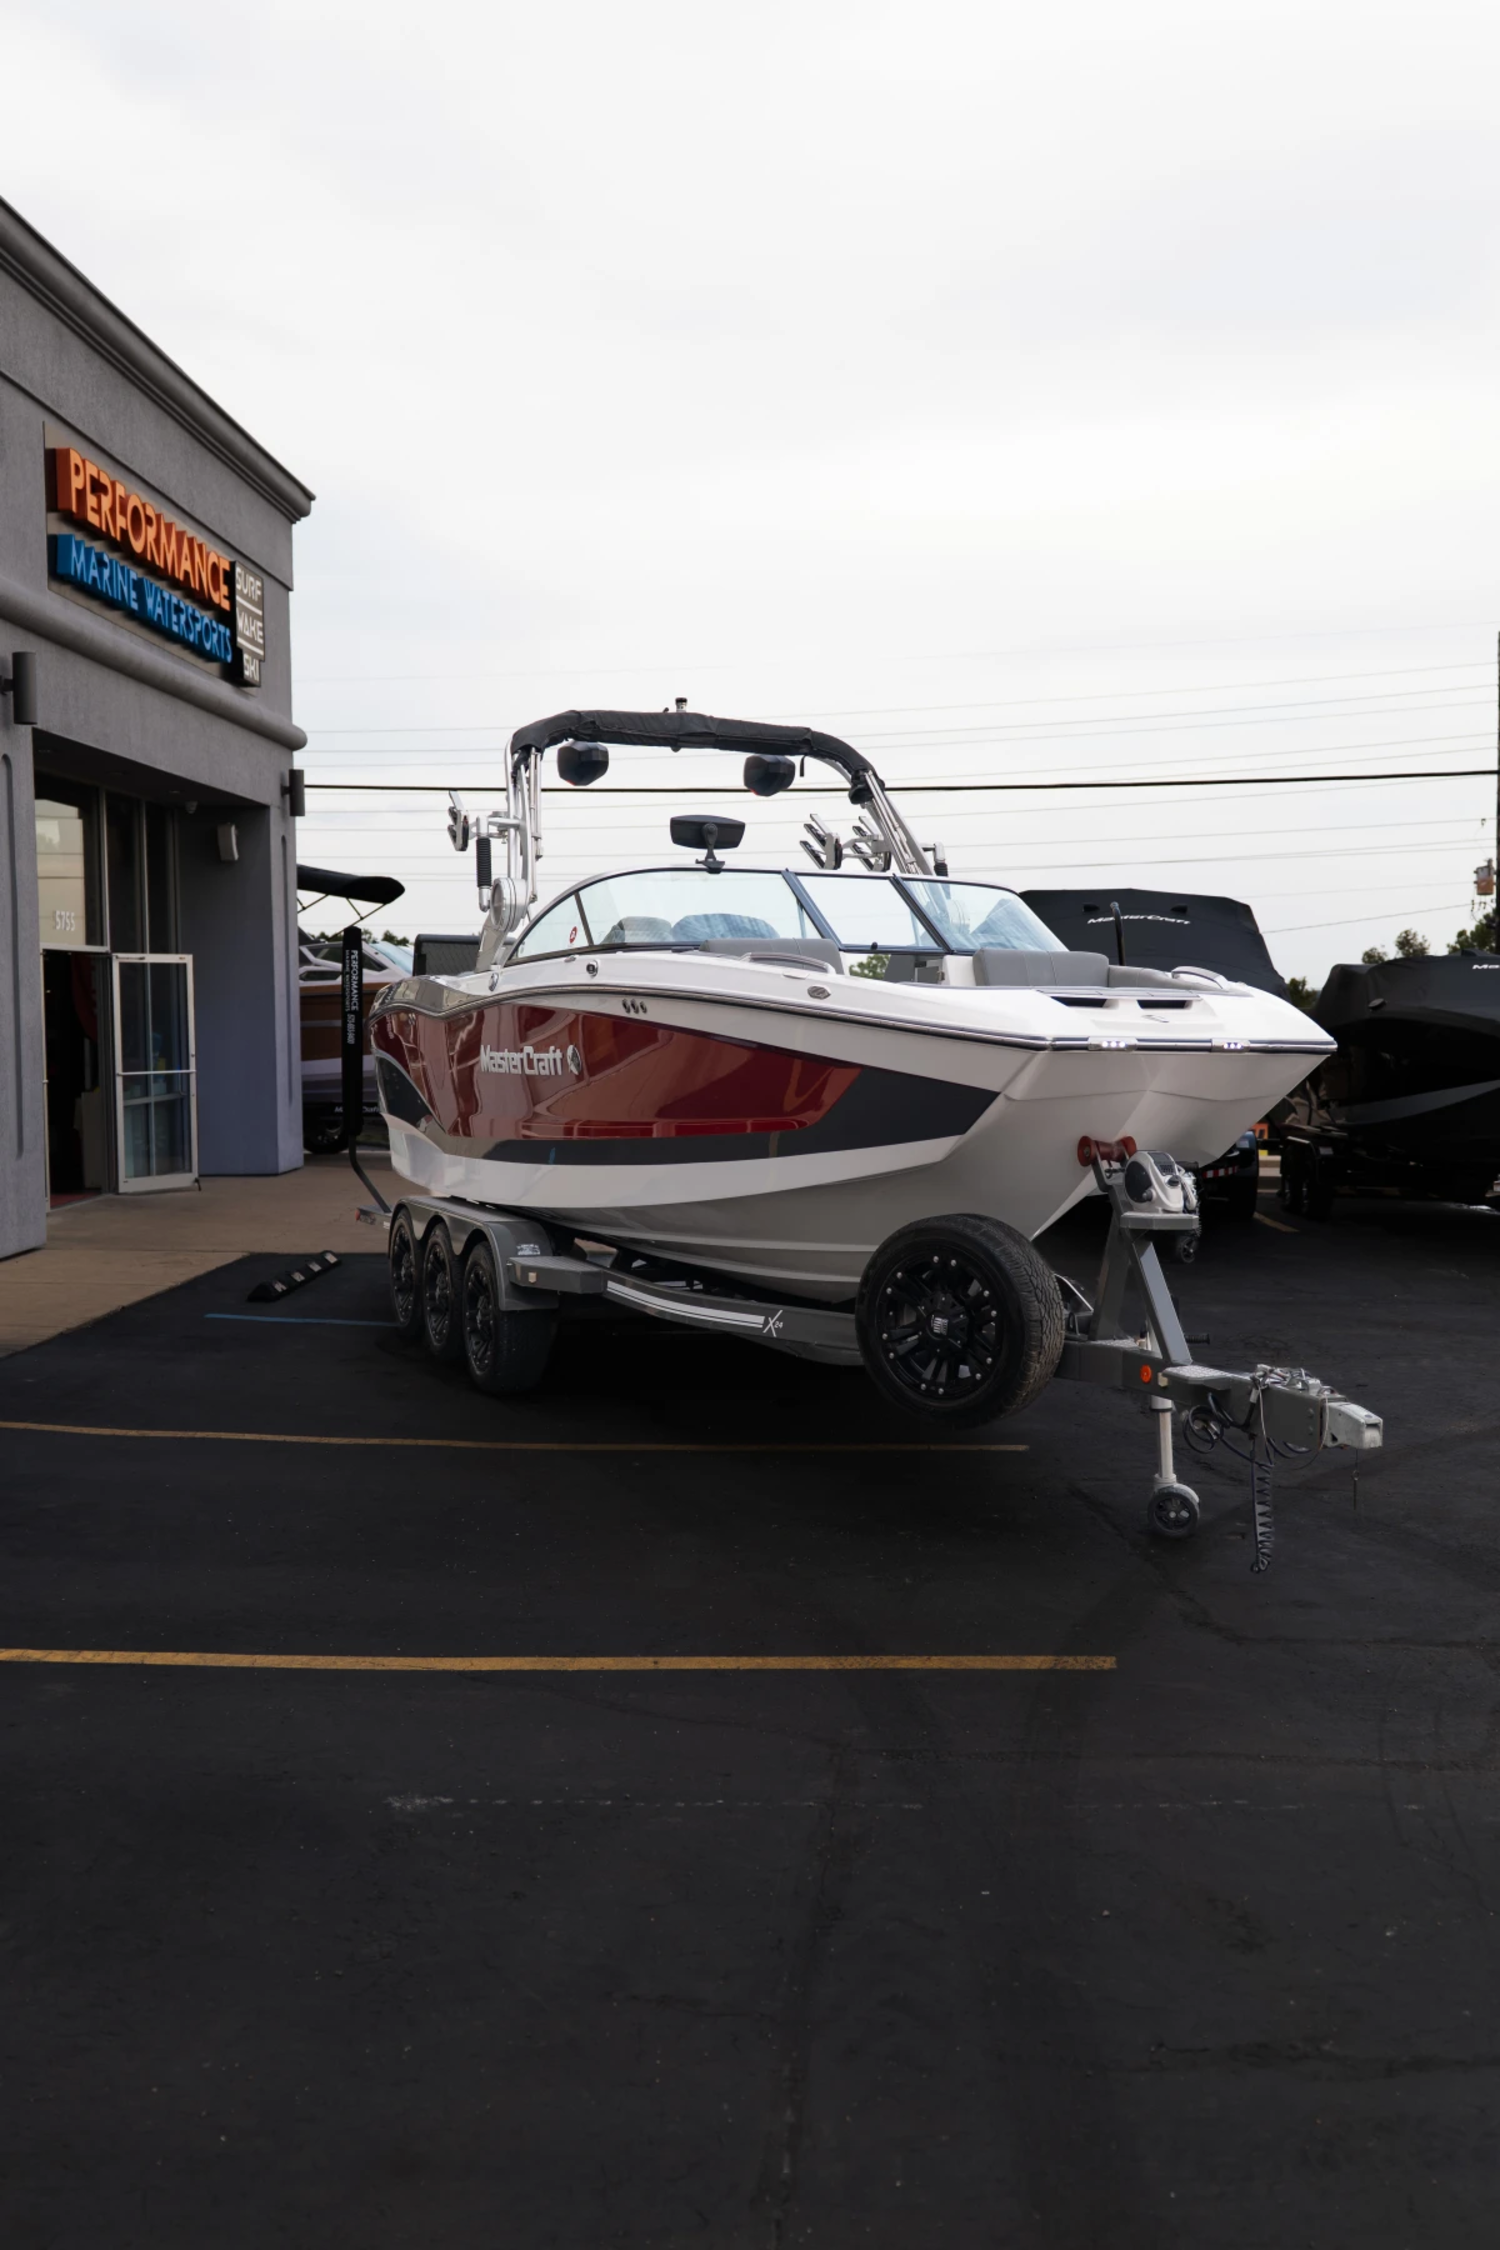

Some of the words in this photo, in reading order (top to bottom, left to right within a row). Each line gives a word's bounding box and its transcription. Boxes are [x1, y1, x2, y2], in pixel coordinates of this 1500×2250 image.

[69, 447, 231, 612] PERFORMANCE
[71, 534, 139, 611] MARINE
[143, 577, 232, 663] WATERSPORTS
[236, 567, 262, 601] SURF
[236, 607, 263, 644] WAKE
[243, 653, 260, 682] SKI
[55, 910, 75, 931] 5755
[350, 949, 359, 1011] PERFORMANCE
[480, 1044, 563, 1076] MasterCraft
